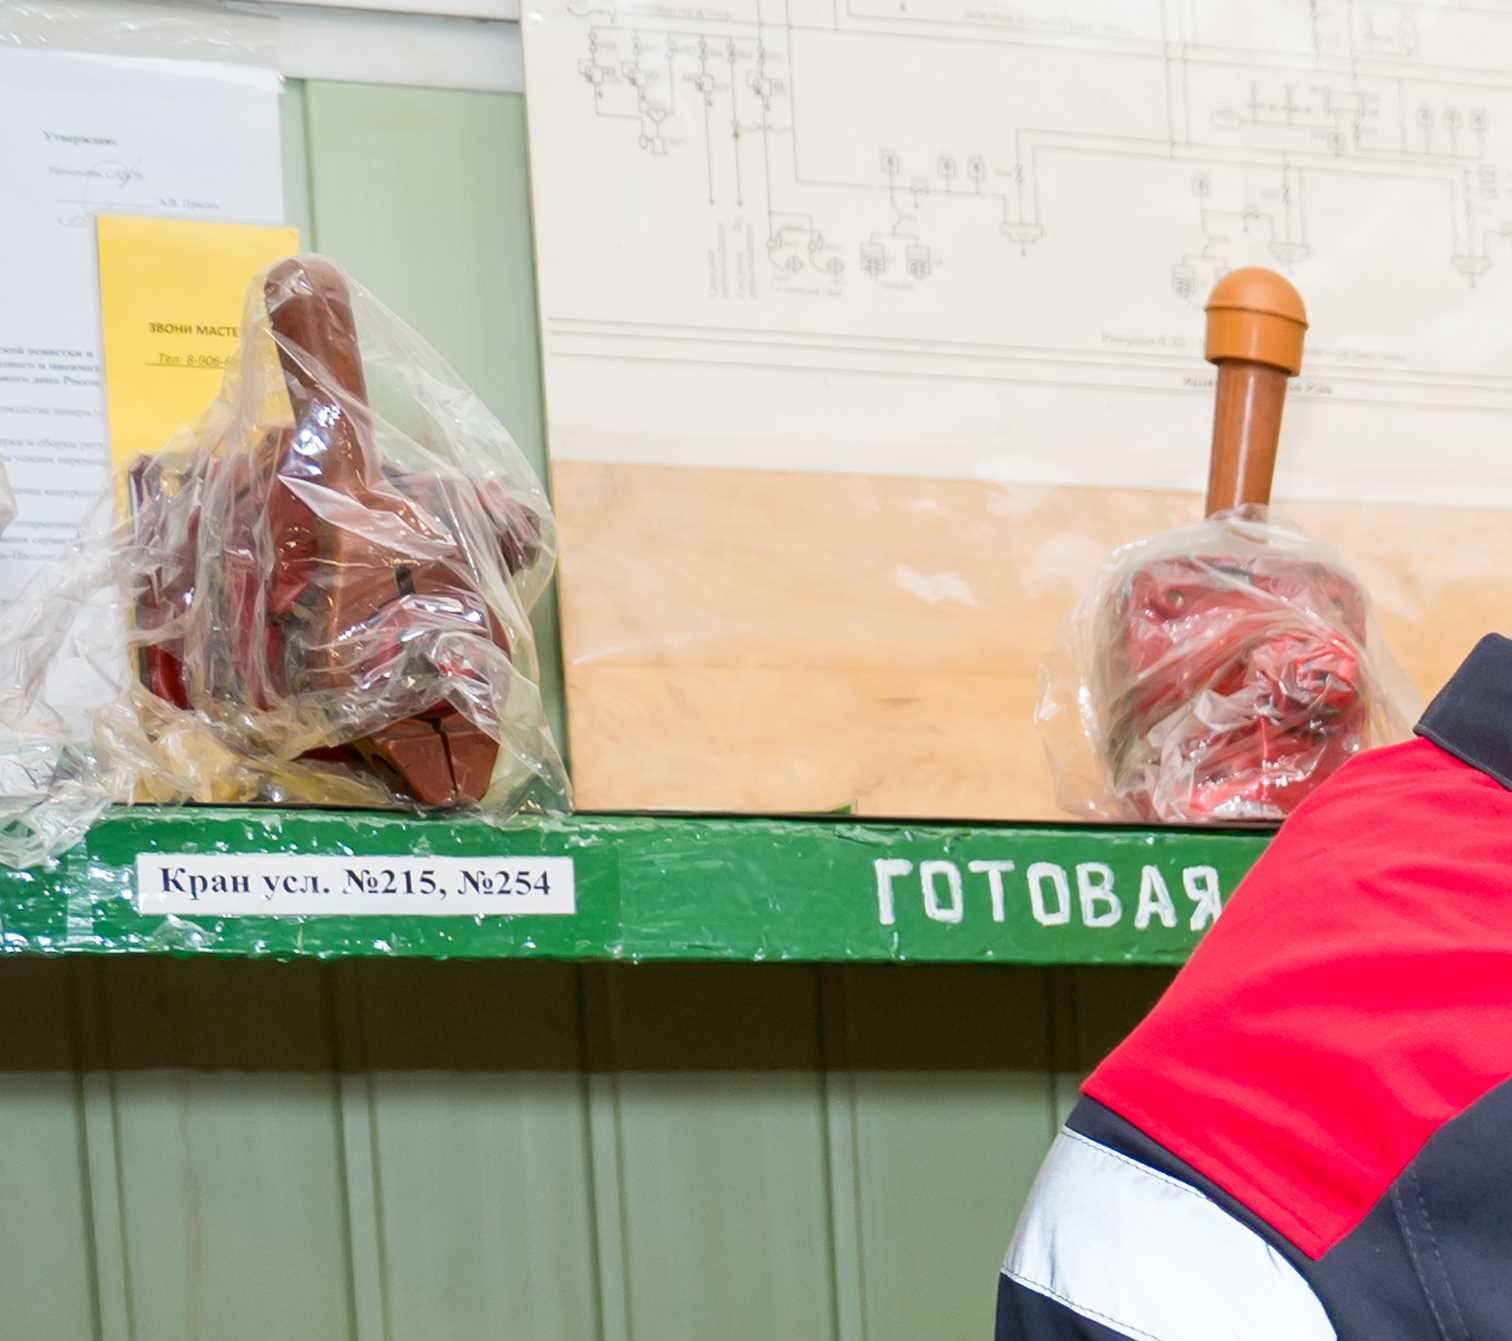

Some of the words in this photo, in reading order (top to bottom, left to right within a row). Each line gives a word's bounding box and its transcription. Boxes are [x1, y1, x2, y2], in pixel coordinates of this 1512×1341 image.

[149, 321, 193, 335] ЗВОНИ
[160, 867, 250, 901] Кран
[262, 871, 331, 900] усл.
[343, 868, 448, 901] №215,
[457, 869, 551, 897] №254
[873, 858, 1223, 931] ГОТОВАЯ
